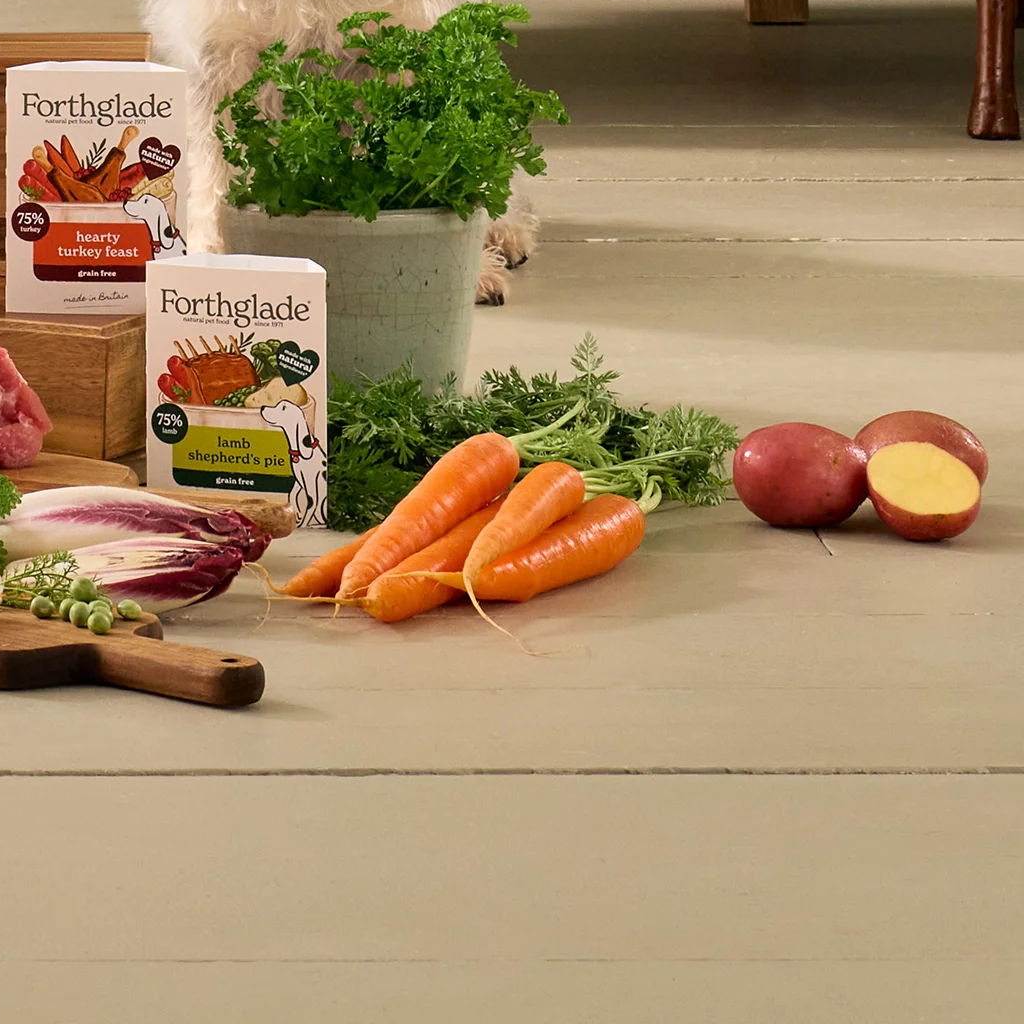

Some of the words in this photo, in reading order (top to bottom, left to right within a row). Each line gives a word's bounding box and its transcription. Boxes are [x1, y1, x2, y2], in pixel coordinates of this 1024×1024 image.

[22, 93, 172, 126] Forthglade
[146, 145, 161, 153] made
[141, 149, 175, 166] natural
[16, 212, 44, 225] 75%
[76, 231, 120, 244] hearty
[58, 246, 102, 259] turkey
[105, 246, 139, 257] feast
[63, 294, 87, 303] made
[98, 291, 129, 301] Britain
[161, 288, 310, 328] Forthglade
[278, 353, 313, 372] natural
[284, 349, 298, 358] made
[299, 356, 311, 364] with
[156, 412, 183, 427] 75%
[217, 436, 251, 449] lamb
[188, 450, 260, 465] shepherd's
[264, 455, 285, 468] pie
[216, 477, 237, 485] grain
[238, 478, 254, 486] free
